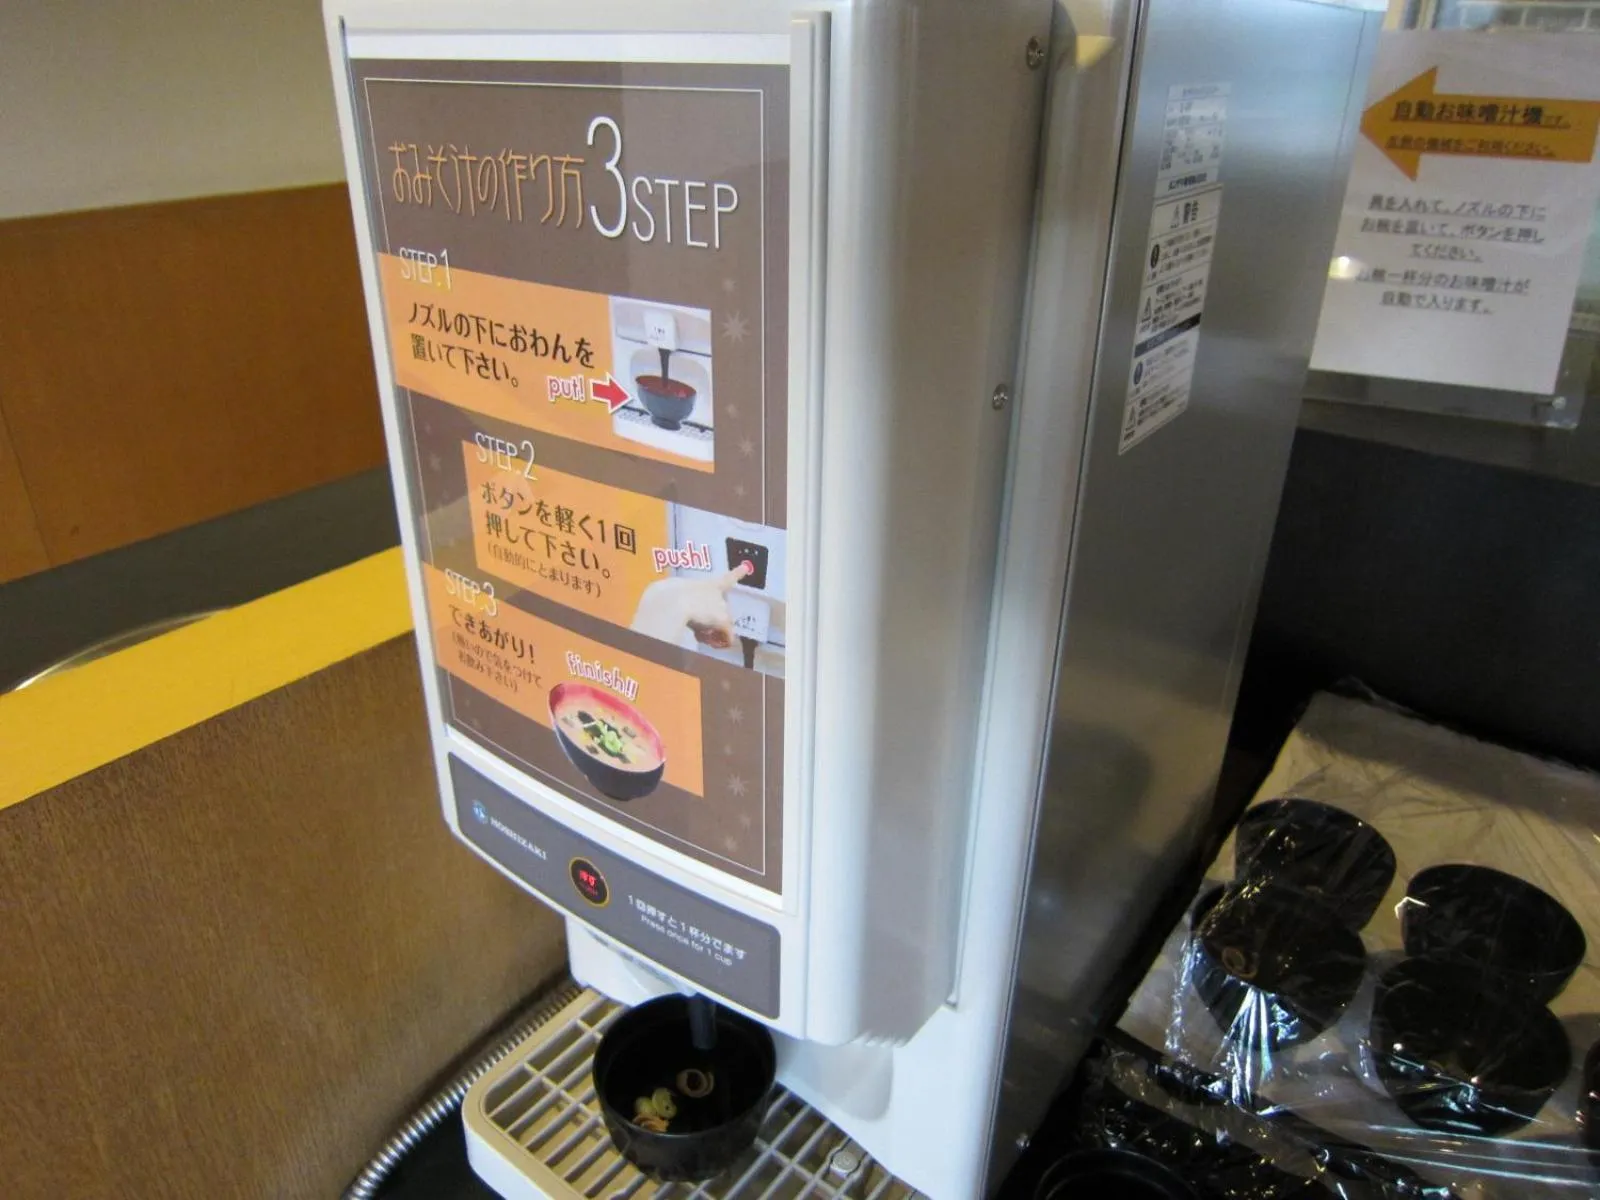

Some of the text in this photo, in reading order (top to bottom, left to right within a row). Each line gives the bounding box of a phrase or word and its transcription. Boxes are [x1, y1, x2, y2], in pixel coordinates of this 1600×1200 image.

[389, 141, 585, 229] おみそ汁の作り方
[408, 302, 596, 369] ノズルの下におわんを
[411, 333, 519, 388] 置いて下さい。
[547, 374, 585, 403] put!
[481, 480, 637, 554] ボタンを軽く1回
[485, 510, 611, 580] 押して下さい。
[653, 541, 711, 571] push!
[566, 651, 640, 700] finish!!
[715, 953, 733, 966] cup
